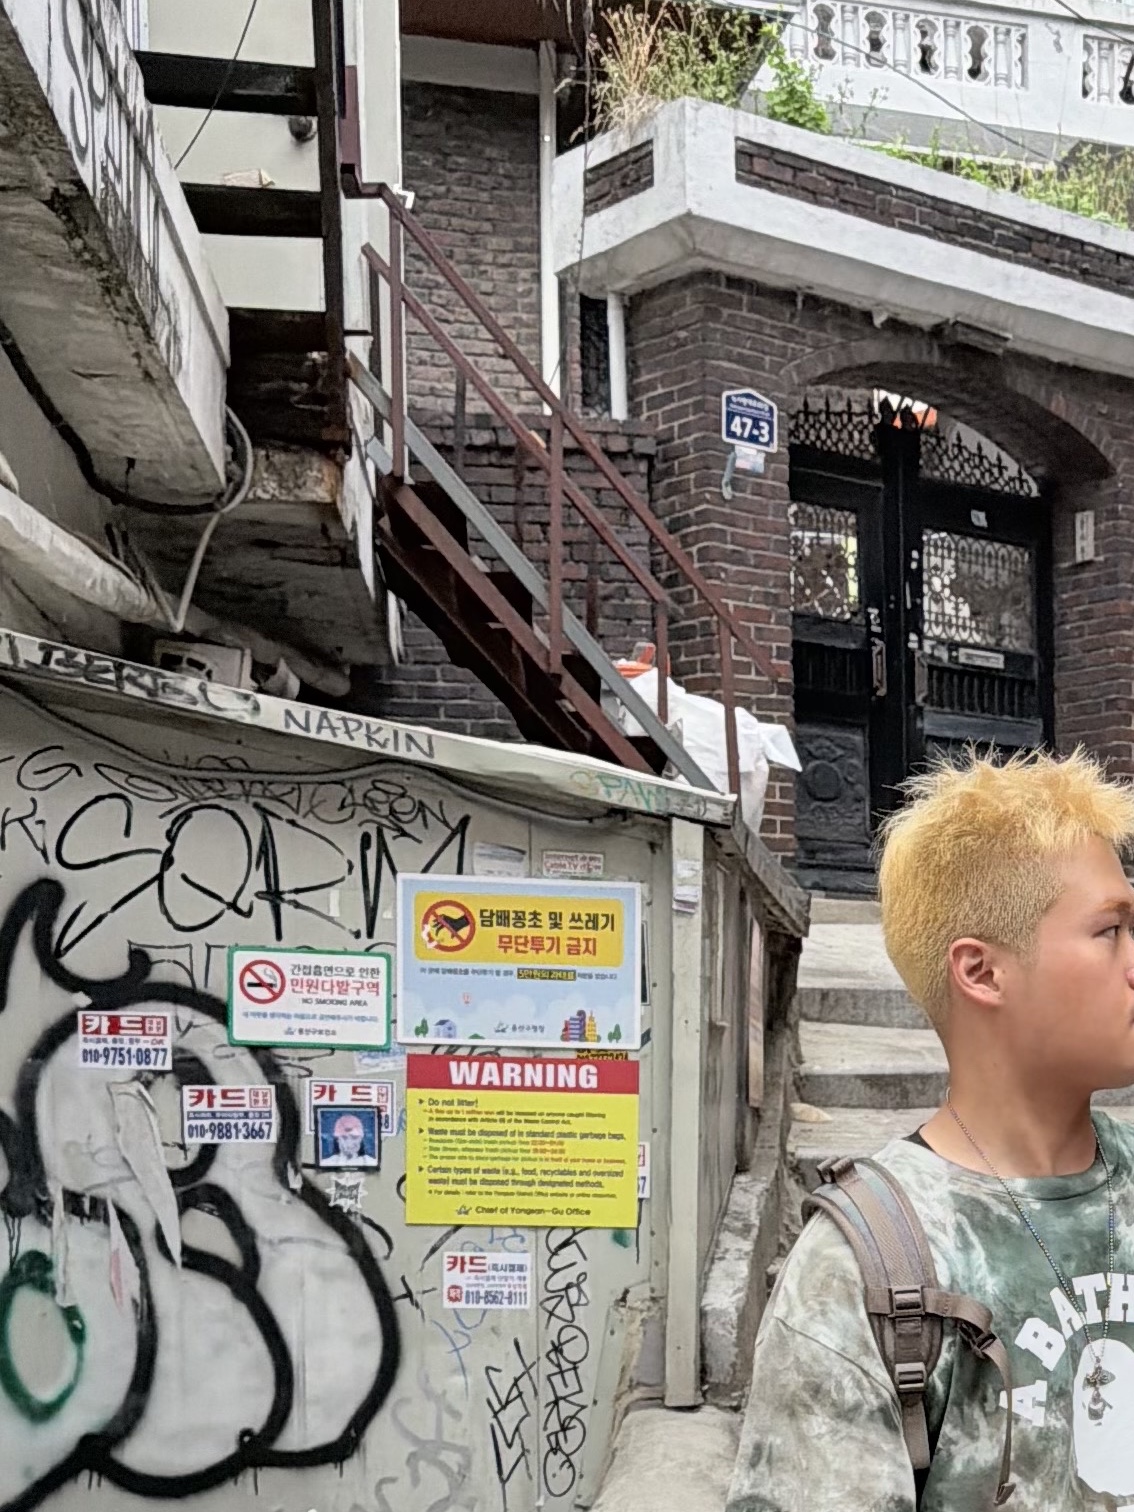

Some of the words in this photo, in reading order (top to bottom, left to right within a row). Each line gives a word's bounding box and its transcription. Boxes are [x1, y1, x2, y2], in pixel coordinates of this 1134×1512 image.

[730, 415, 770, 443] 47-3
[283, 707, 436, 760] NAPKIN
[479, 908, 543, 929] 담배꽁초
[548, 911, 563, 930] 및
[569, 911, 615, 932] 쓰레기
[497, 934, 561, 955] 무단투기
[566, 936, 597, 957] 금지
[290, 964, 355, 977] 간접흡연으로
[359, 967, 380, 979] 인한
[290, 979, 380, 996] 민원다발구역
[449, 1060, 599, 1089] WARNING
[188, 1088, 246, 1108] 카드
[428, 1098, 439, 1106] Do
[500, 1207, 508, 1215] of
[565, 1208, 591, 1216] Office
[446, 1255, 487, 1273] 카드
[1000, 1379, 1048, 1428] A
